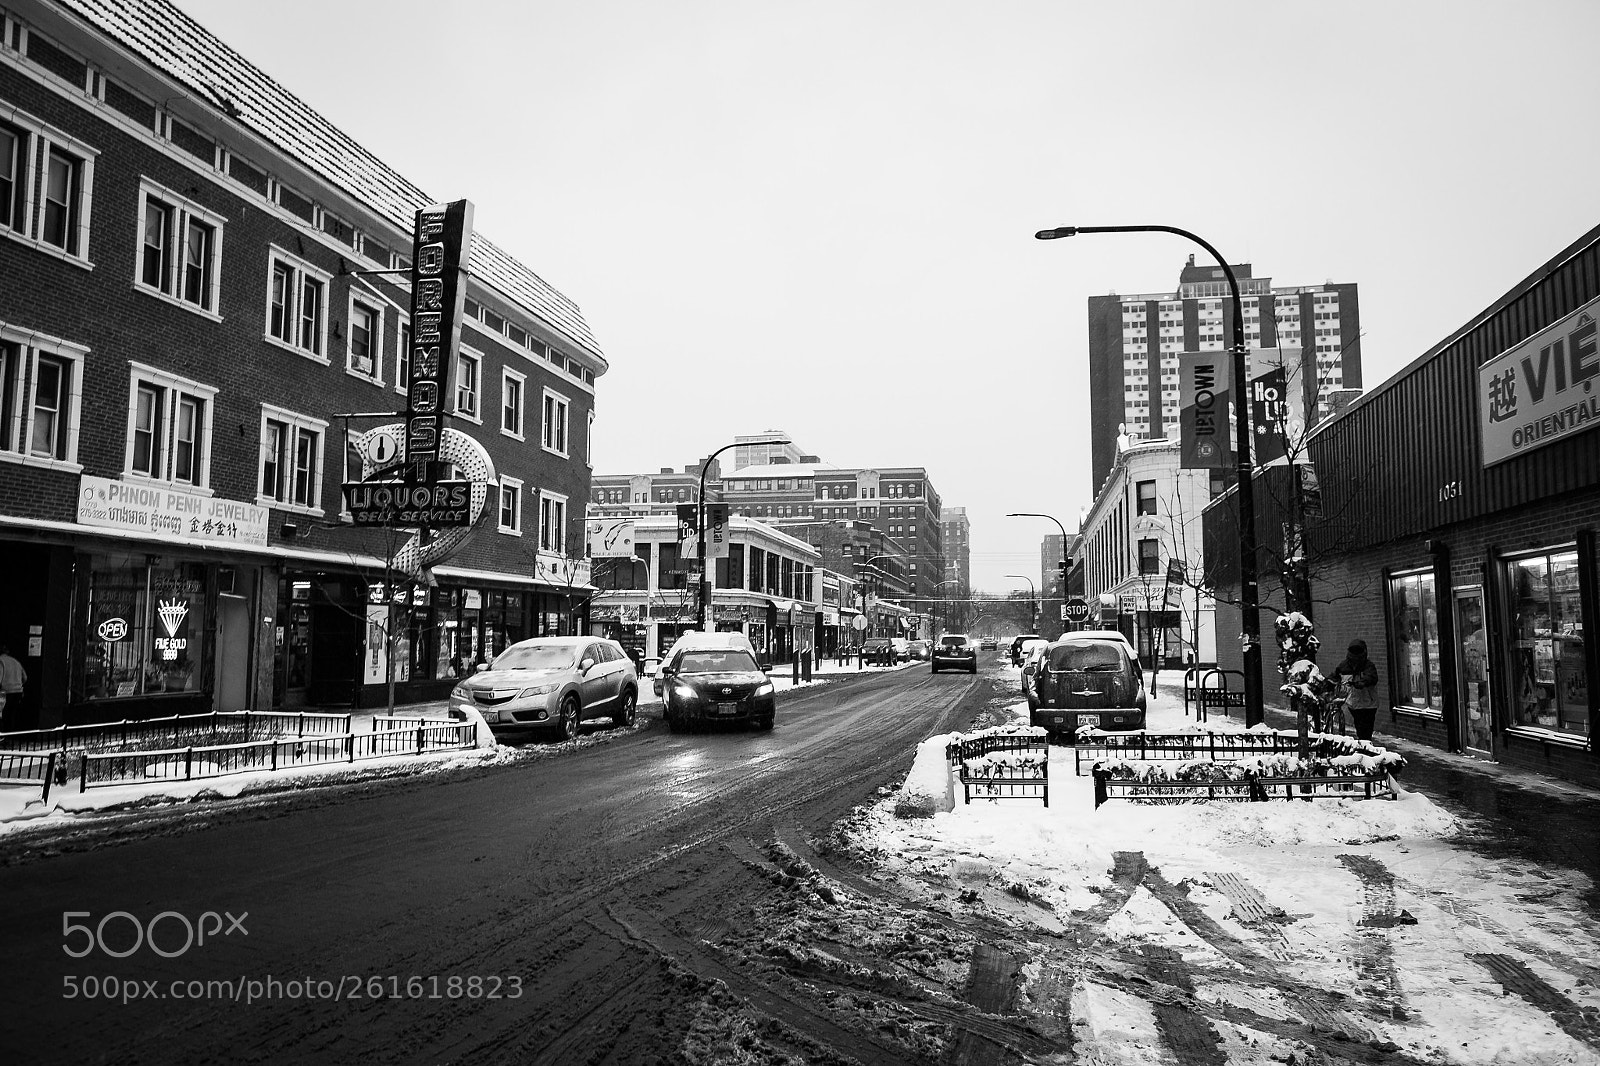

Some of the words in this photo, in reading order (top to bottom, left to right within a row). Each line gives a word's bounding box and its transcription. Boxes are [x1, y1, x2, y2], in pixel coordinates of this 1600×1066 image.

[408, 210, 446, 483] FOREMOST
[1194, 365, 1215, 436] UPTOWN
[1254, 382, 1278, 401] HO
[1488, 366, 1518, 424] 越
[1511, 396, 1600, 449] ORIENTAL
[350, 485, 467, 508] LIQUORS
[1439, 481, 1463, 502] 1051
[109, 484, 161, 508] PHNOM
[167, 495, 202, 515] PENH
[208, 501, 264, 525] JEWELRY
[400, 508, 467, 522] SERVICE
[713, 509, 723, 543] UPTOWN
[1066, 605, 1088, 615] STOP
[99, 622, 127, 637] OPEN
[170, 638, 187, 649] GOLD
